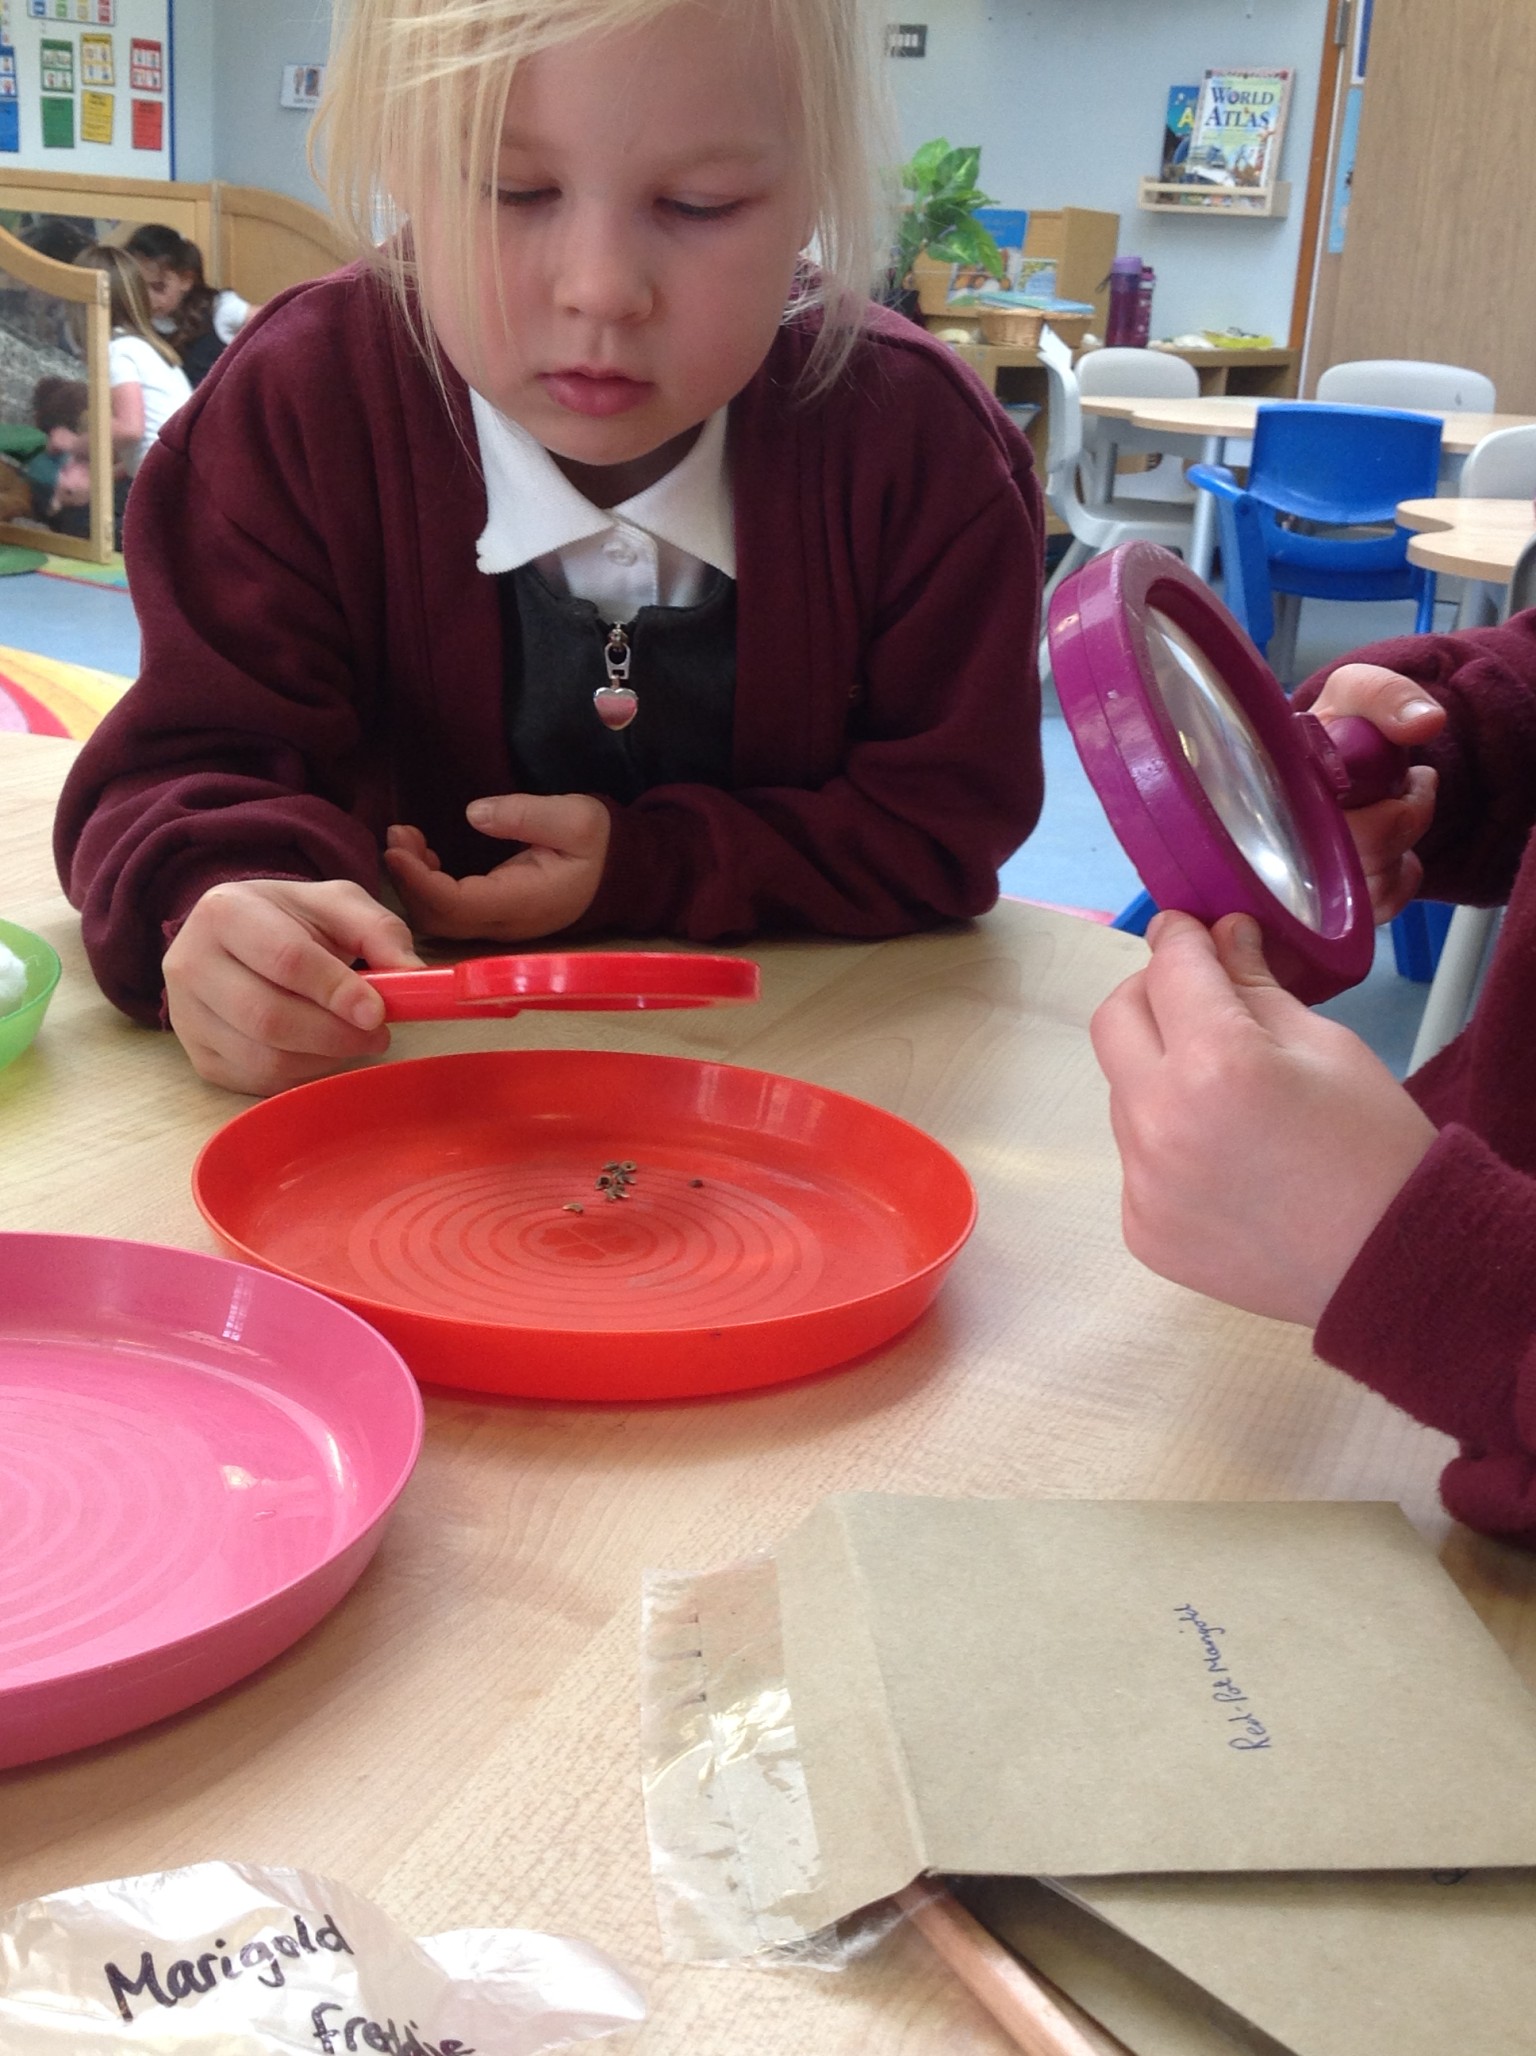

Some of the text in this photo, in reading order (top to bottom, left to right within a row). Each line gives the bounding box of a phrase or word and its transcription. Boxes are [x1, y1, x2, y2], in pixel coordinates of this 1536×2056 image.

[1210, 86, 1274, 105] WORLD
[1204, 105, 1271, 128] ATLAS
[104, 1913, 354, 2022] Marigold
